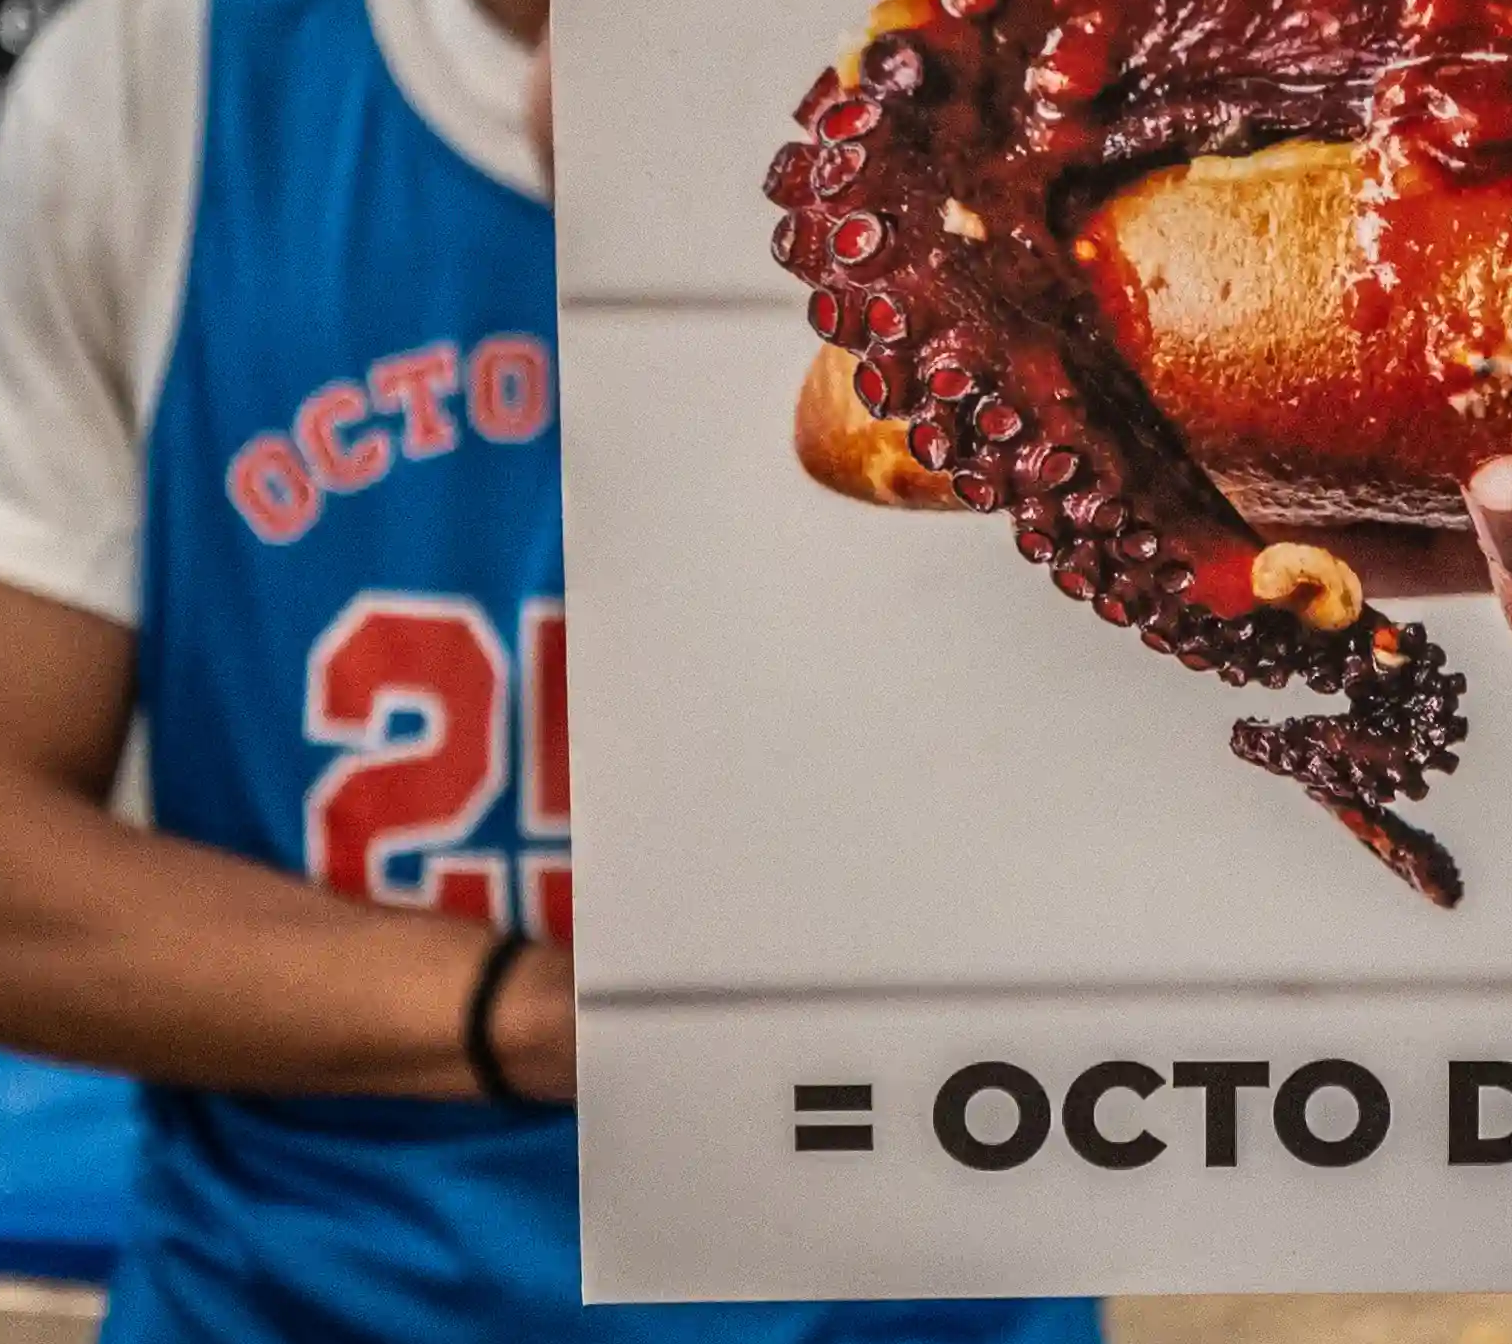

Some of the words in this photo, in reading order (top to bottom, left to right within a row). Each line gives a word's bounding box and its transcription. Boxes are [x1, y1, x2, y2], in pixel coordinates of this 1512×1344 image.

[225, 333, 550, 546] OCTO
[794, 1083, 873, 1153] =
[932, 1059, 1391, 1171] OCTO
